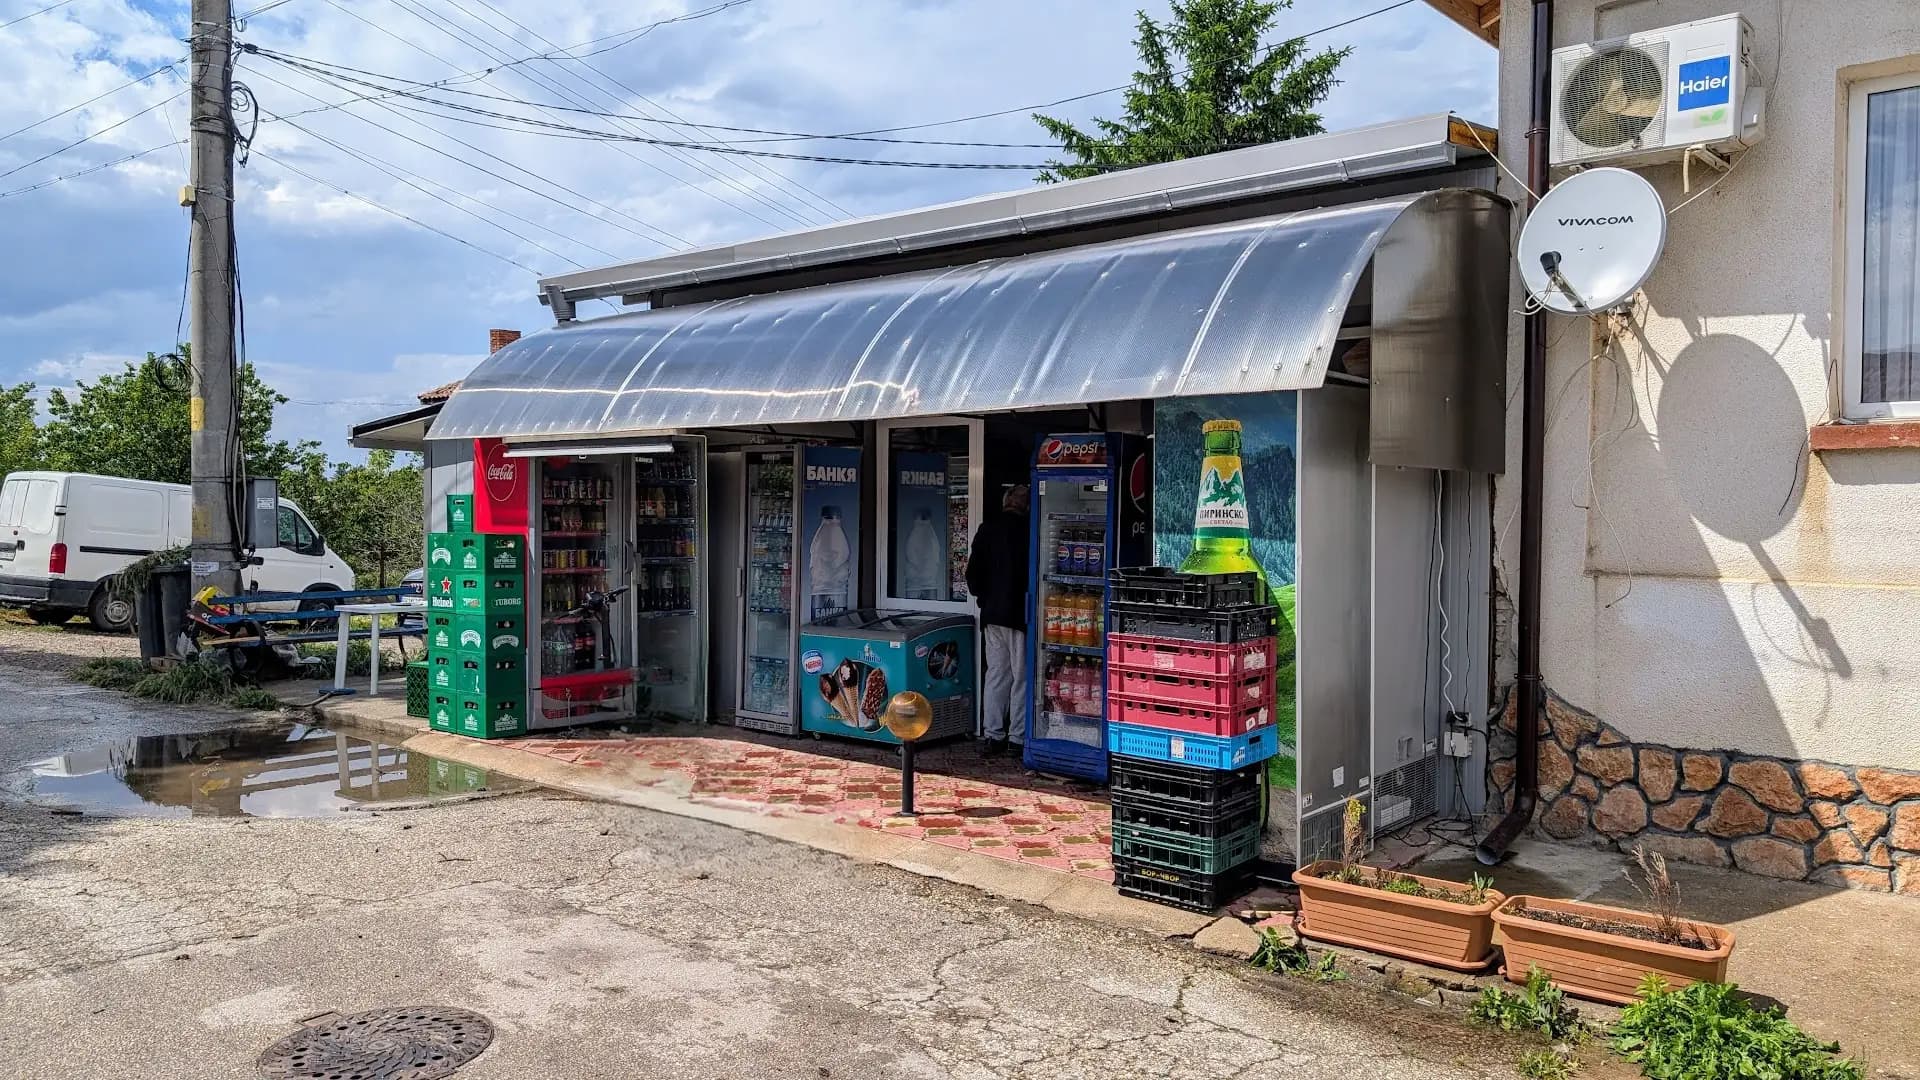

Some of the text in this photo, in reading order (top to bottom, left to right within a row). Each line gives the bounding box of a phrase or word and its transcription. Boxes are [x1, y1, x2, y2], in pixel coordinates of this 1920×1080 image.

[1680, 74, 1728, 96] Haier
[1558, 215, 1634, 227] VIVACOM
[1063, 442, 1098, 457] pepsi
[806, 465, 856, 483] БАНКЯ
[495, 597, 522, 606] TUBORG
